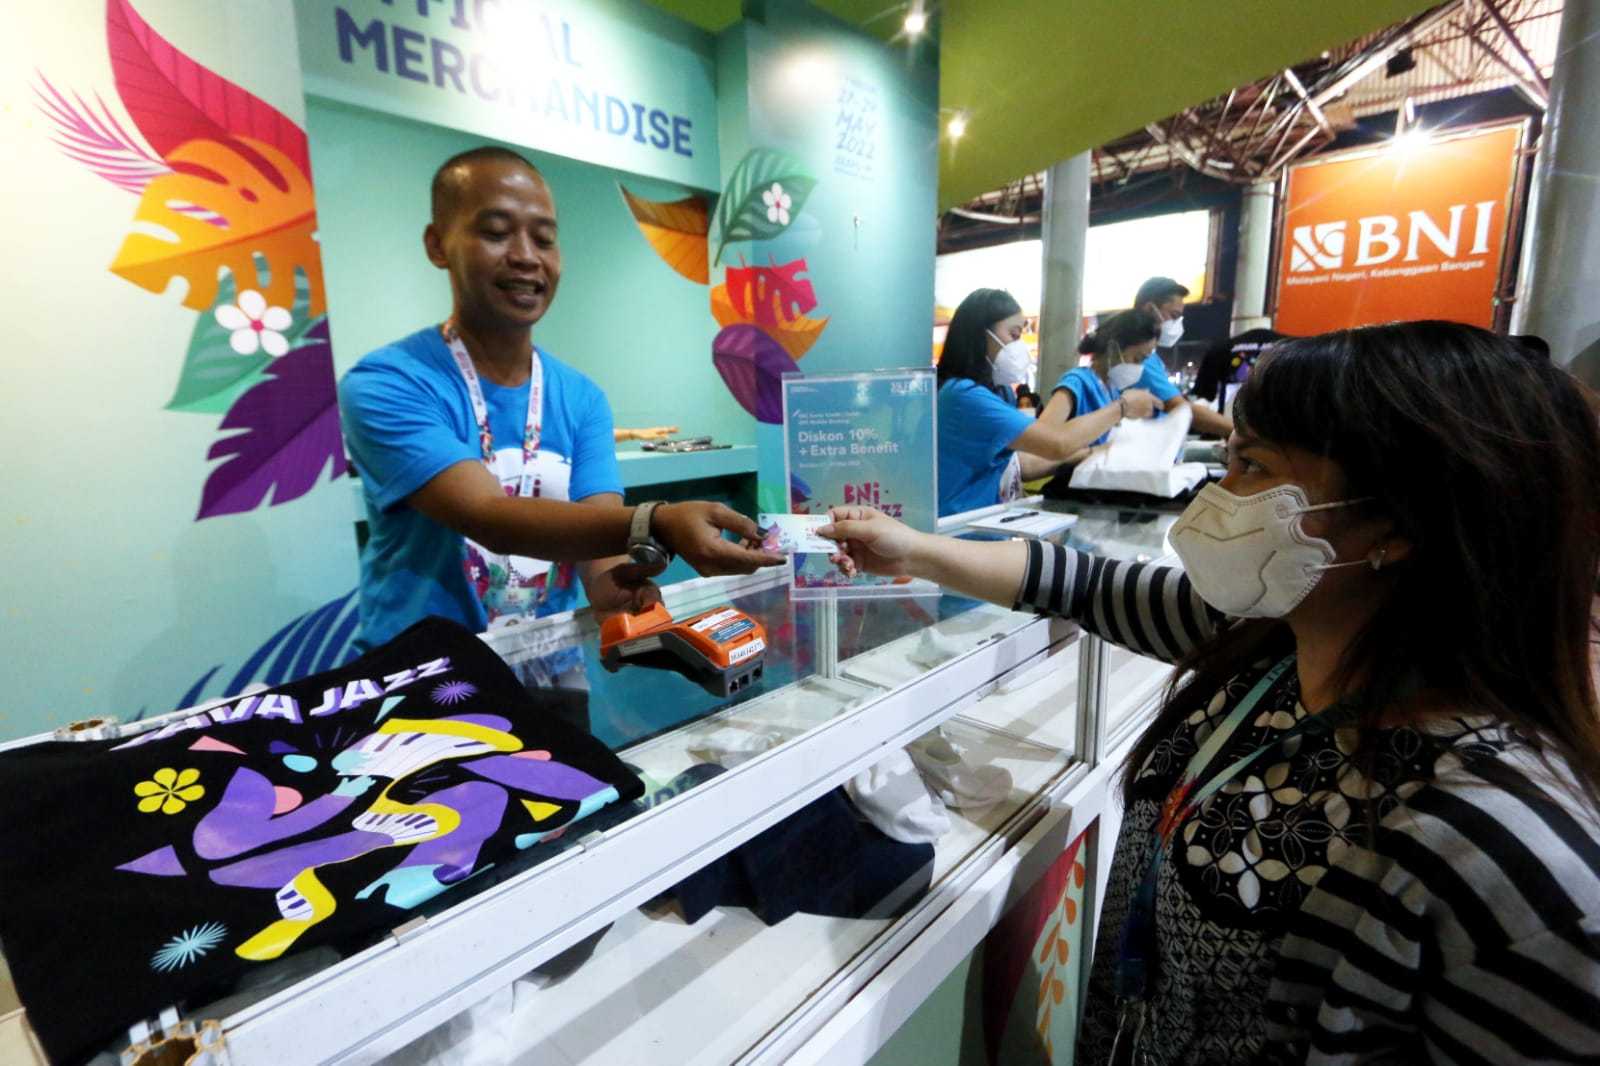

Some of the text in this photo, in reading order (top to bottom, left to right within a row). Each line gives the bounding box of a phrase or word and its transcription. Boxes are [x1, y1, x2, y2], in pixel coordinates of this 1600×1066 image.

[336, 6, 694, 158] MERCANDISE
[1354, 200, 1496, 267] BNI
[798, 427, 878, 443] Diskon 10%
[810, 444, 847, 457] Extra
[850, 441, 899, 455] Benefit
